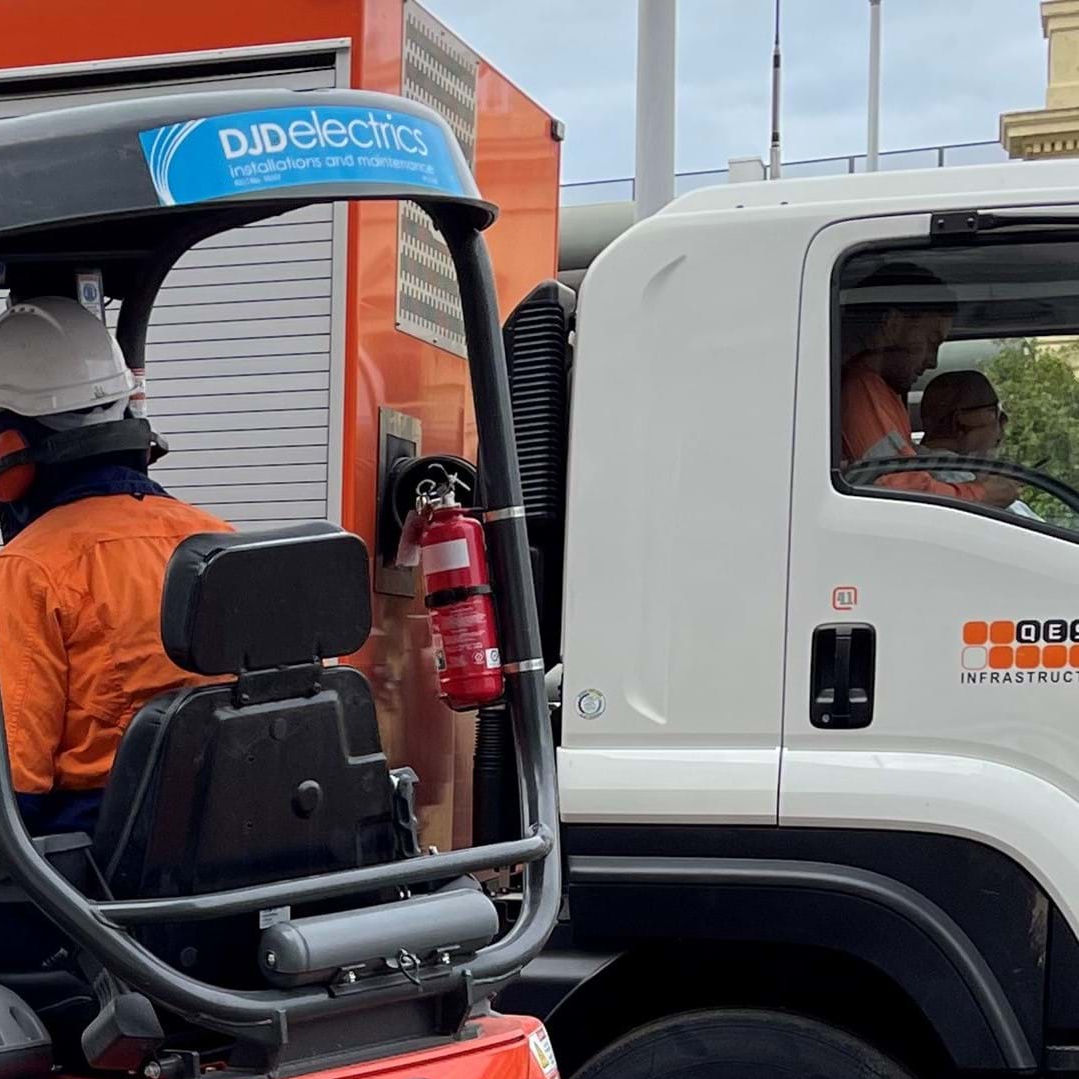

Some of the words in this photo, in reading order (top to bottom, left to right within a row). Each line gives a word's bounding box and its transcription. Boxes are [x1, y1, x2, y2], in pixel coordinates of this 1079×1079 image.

[218, 110, 428, 159] DJDelectrics
[230, 156, 322, 178] installations
[326, 154, 354, 167] and
[358, 156, 434, 175] maintenance
